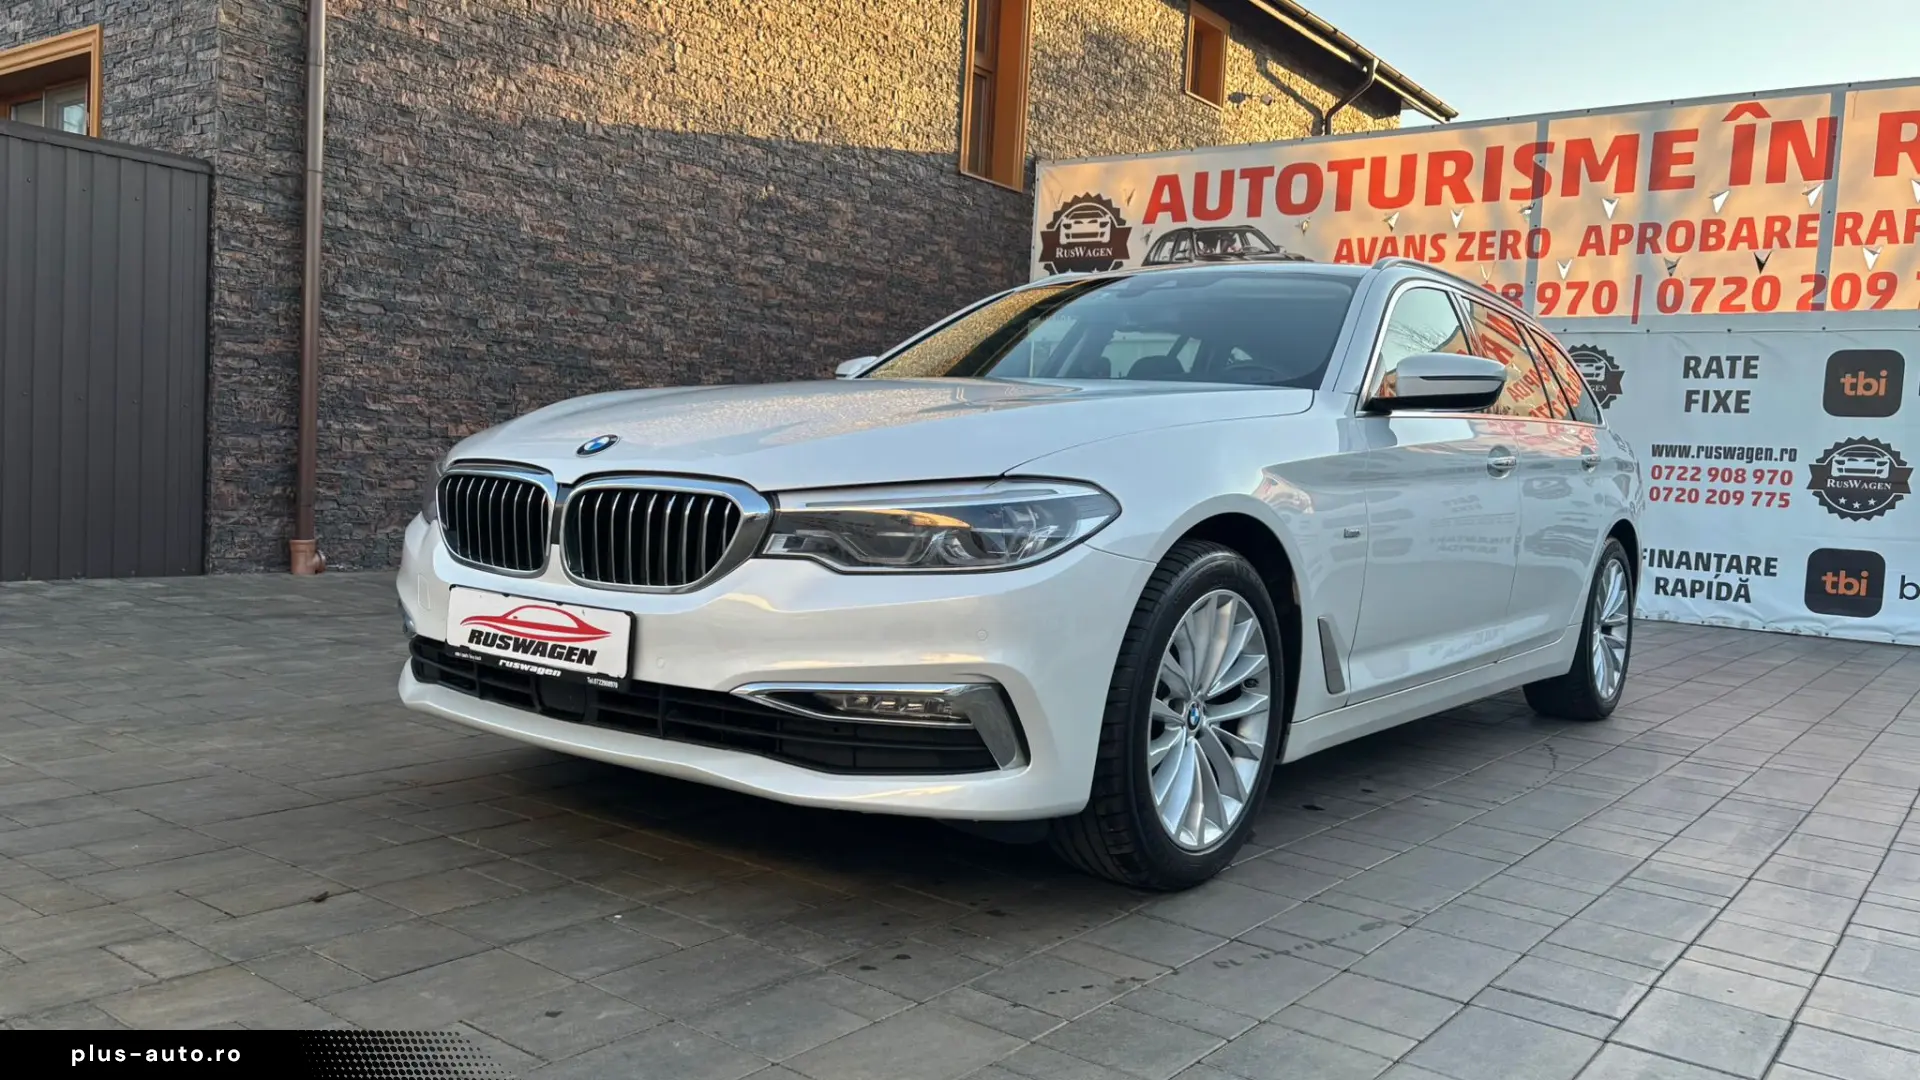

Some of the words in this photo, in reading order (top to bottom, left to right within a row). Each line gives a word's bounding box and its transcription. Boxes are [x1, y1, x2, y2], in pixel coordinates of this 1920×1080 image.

[1142, 128, 1699, 225] AUTOTURISME
[1721, 102, 1838, 187] ÎN
[1874, 111, 1920, 177] R
[1333, 233, 1446, 264] AVANS
[1456, 228, 1551, 262] ZERO
[1577, 213, 1820, 257] APROBARE
[1536, 280, 1618, 315] 970
[1656, 275, 1781, 314] 0720
[1796, 271, 1898, 312] 209
[1683, 355, 1760, 380] RATE
[1840, 370, 1887, 397] tbi
[1684, 389, 1751, 414] FIXE
[1651, 443, 1798, 464] www.ruswagen.ro
[1651, 464, 1702, 481] 0722
[1707, 467, 1747, 484] 908
[1752, 469, 1794, 486] 970
[1648, 486, 1700, 504] 0720
[1705, 489, 1745, 506] 209
[1751, 491, 1791, 508] 775
[1654, 576, 1752, 603] RAPIDĂ
[1821, 570, 1869, 597] tbi
[468, 629, 598, 666] RUSWAGEN
[499, 658, 562, 678] ruswagen
